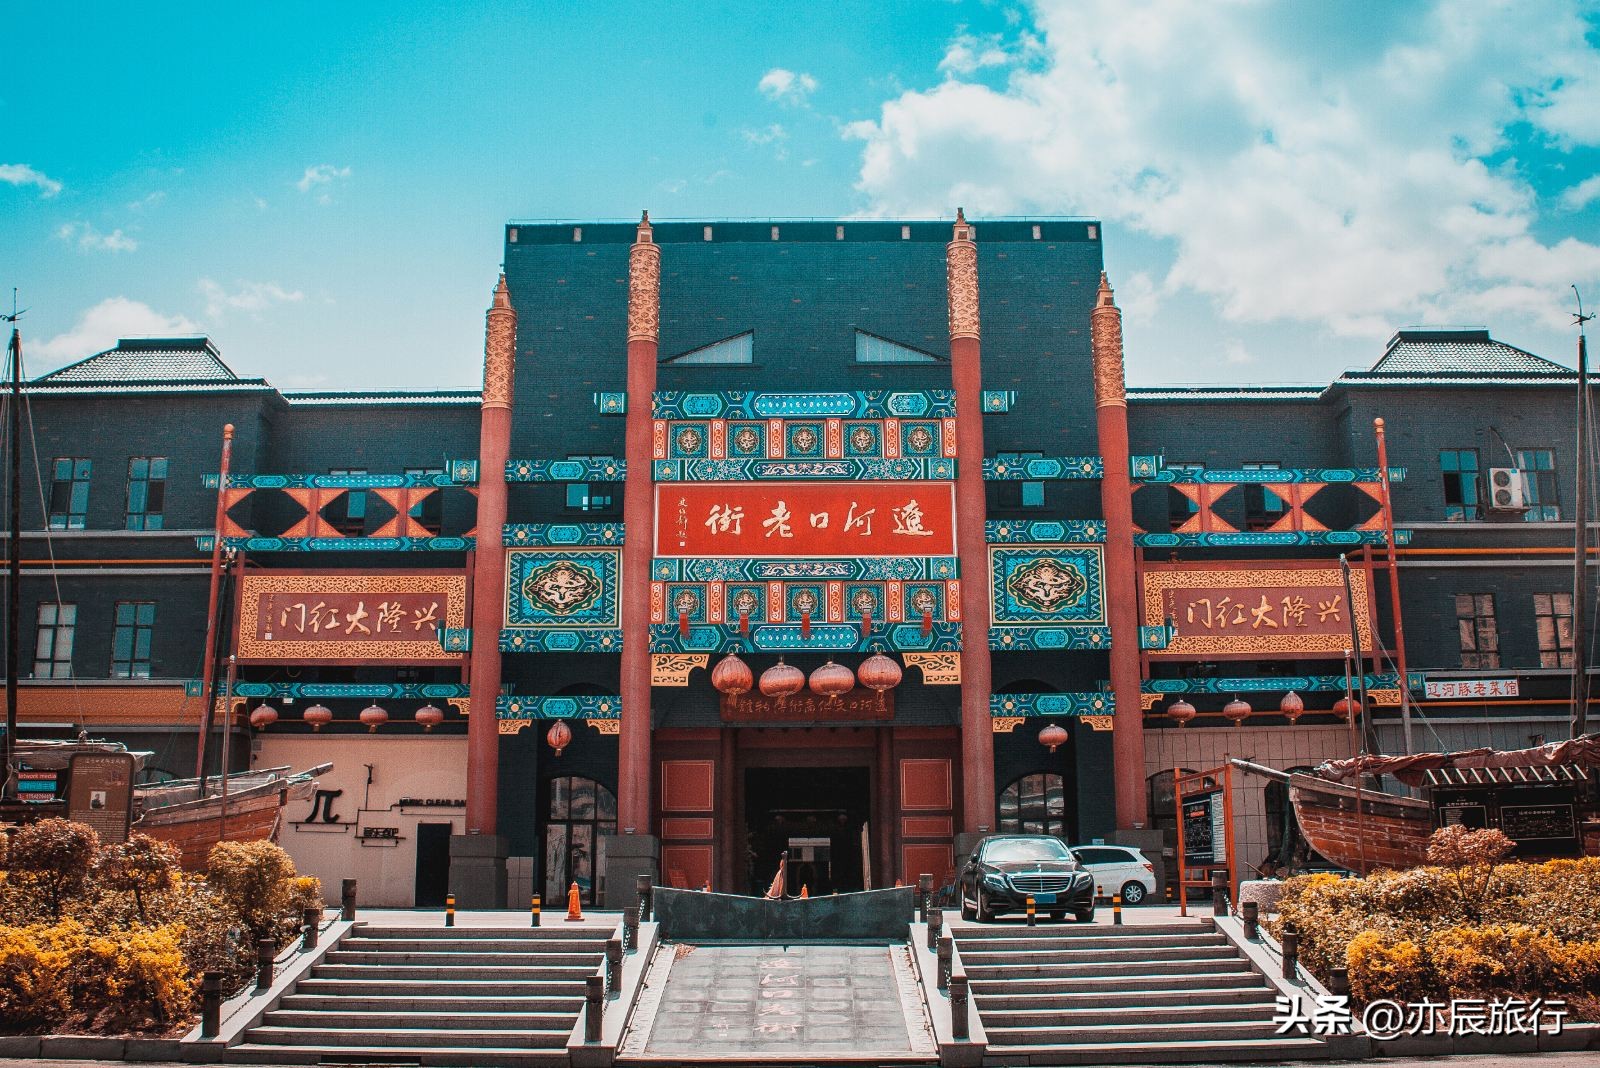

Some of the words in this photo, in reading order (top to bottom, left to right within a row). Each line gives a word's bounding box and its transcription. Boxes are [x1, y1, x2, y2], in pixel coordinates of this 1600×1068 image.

[1426, 681, 1518, 698] 辽河豚老菜馆
